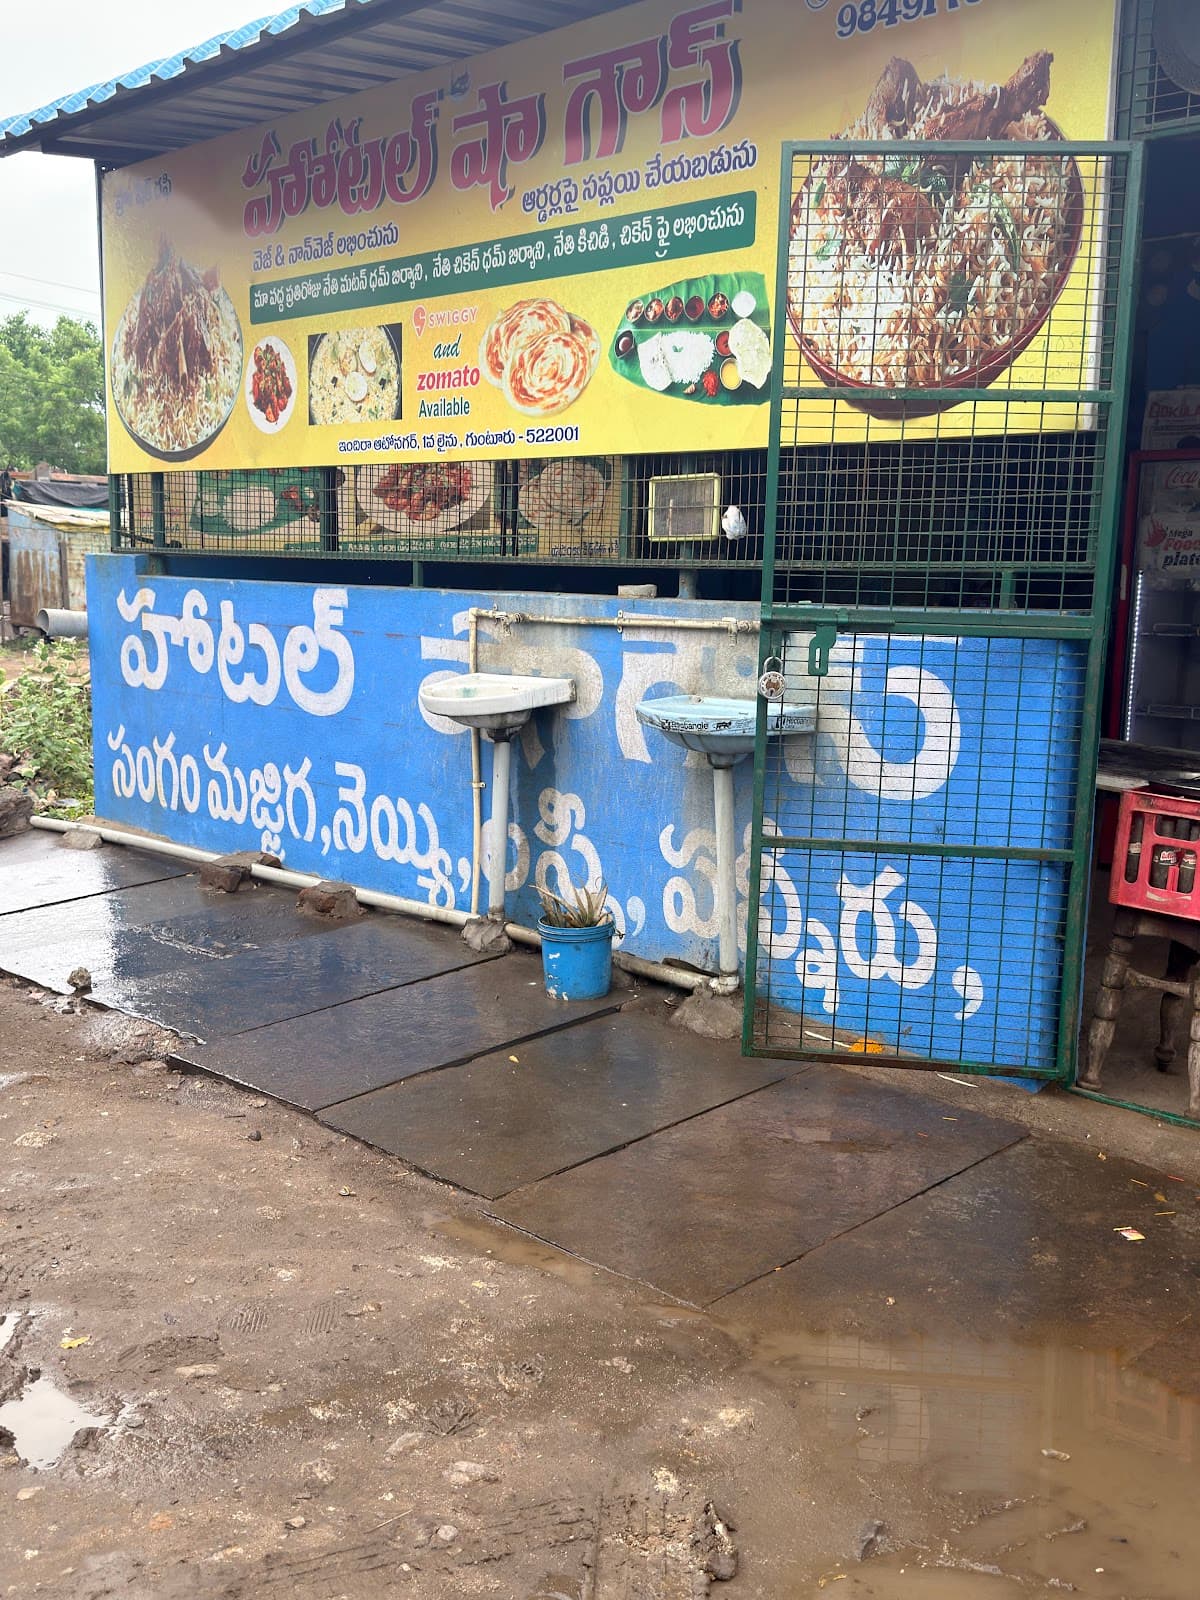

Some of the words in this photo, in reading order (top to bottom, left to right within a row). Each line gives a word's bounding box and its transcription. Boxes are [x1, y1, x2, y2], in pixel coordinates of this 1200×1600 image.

[645, 140, 757, 187] చేయబడును
[254, 290, 269, 308] మా
[323, 272, 339, 297] నేతి
[340, 267, 368, 294] మటన్
[369, 264, 390, 292] ధమ్
[433, 252, 451, 278] నేతి
[453, 247, 480, 275] చికెన్
[483, 243, 506, 273] ధమ్
[554, 228, 575, 257] నేతి
[620, 215, 652, 246] చికెన్
[673, 203, 745, 238] లభించును
[274, 246, 286, 267] &
[337, 222, 399, 256] లభించును
[428, 306, 478, 328] SWIGGY
[433, 333, 462, 359] and
[417, 364, 480, 392] zomato
[418, 396, 471, 418] Available
[526, 425, 579, 444] 522001
[116, 588, 354, 716] హోటల్
[107, 724, 201, 813] సంగం
